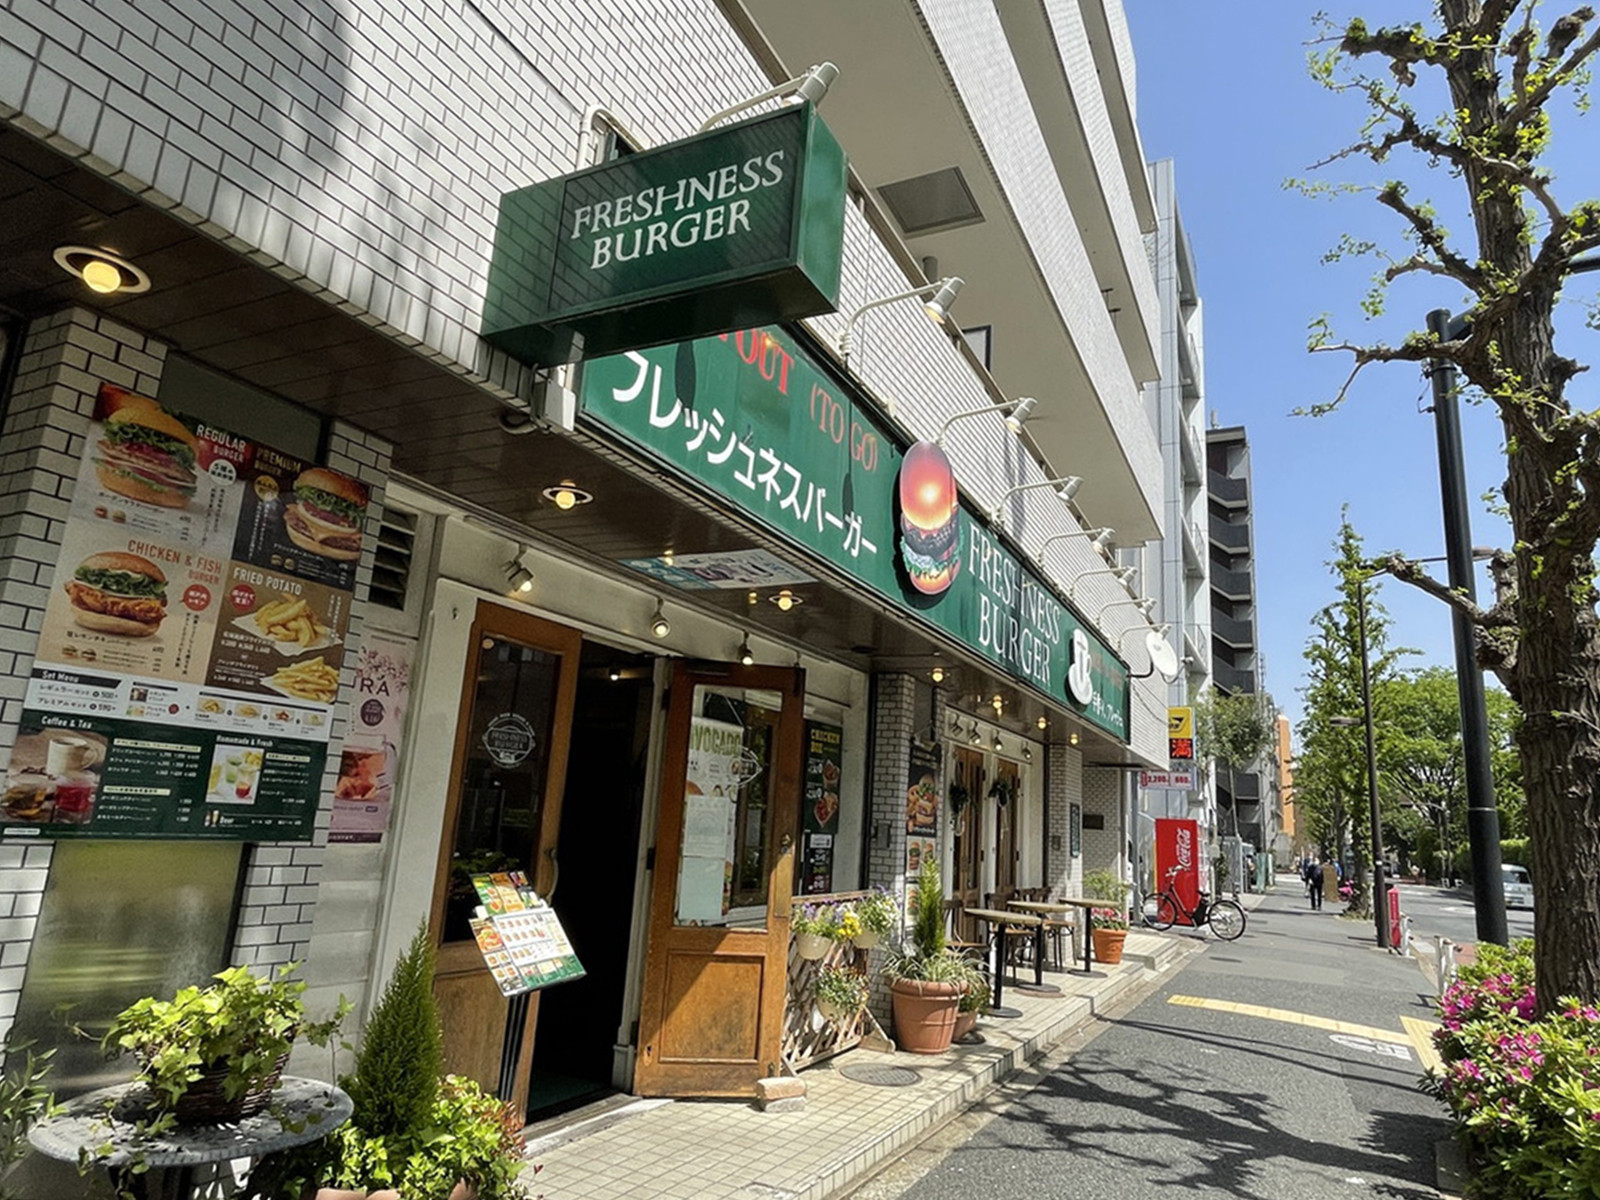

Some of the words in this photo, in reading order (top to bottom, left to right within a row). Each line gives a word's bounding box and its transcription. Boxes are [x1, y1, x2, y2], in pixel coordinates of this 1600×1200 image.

[571, 150, 785, 240] FRESHNESS
[590, 198, 752, 270] BURGER
[196, 424, 247, 453] REGULAR
[213, 445, 244, 463] BURGER
[256, 447, 302, 475] PREMIUM
[612, 350, 878, 558] フレッシュネスバーガー
[127, 540, 181, 564] CHICKEN
[184, 554, 193, 567] &
[196, 558, 222, 575] FISH
[188, 570, 220, 585] BURGER
[233, 567, 263, 586] FRIED
[266, 576, 302, 596] POTATO
[968, 522, 1062, 646] FRESHNESS
[979, 592, 1051, 687] BURGER
[42, 670, 56, 680] Set
[57, 673, 79, 683] Menu
[41, 715, 68, 728] Coffee
[71, 720, 76, 728] &
[78, 720, 92, 729] Tea
[810, 728, 840, 743] CHICKEN
[1171, 739, 1192, 758] 満
